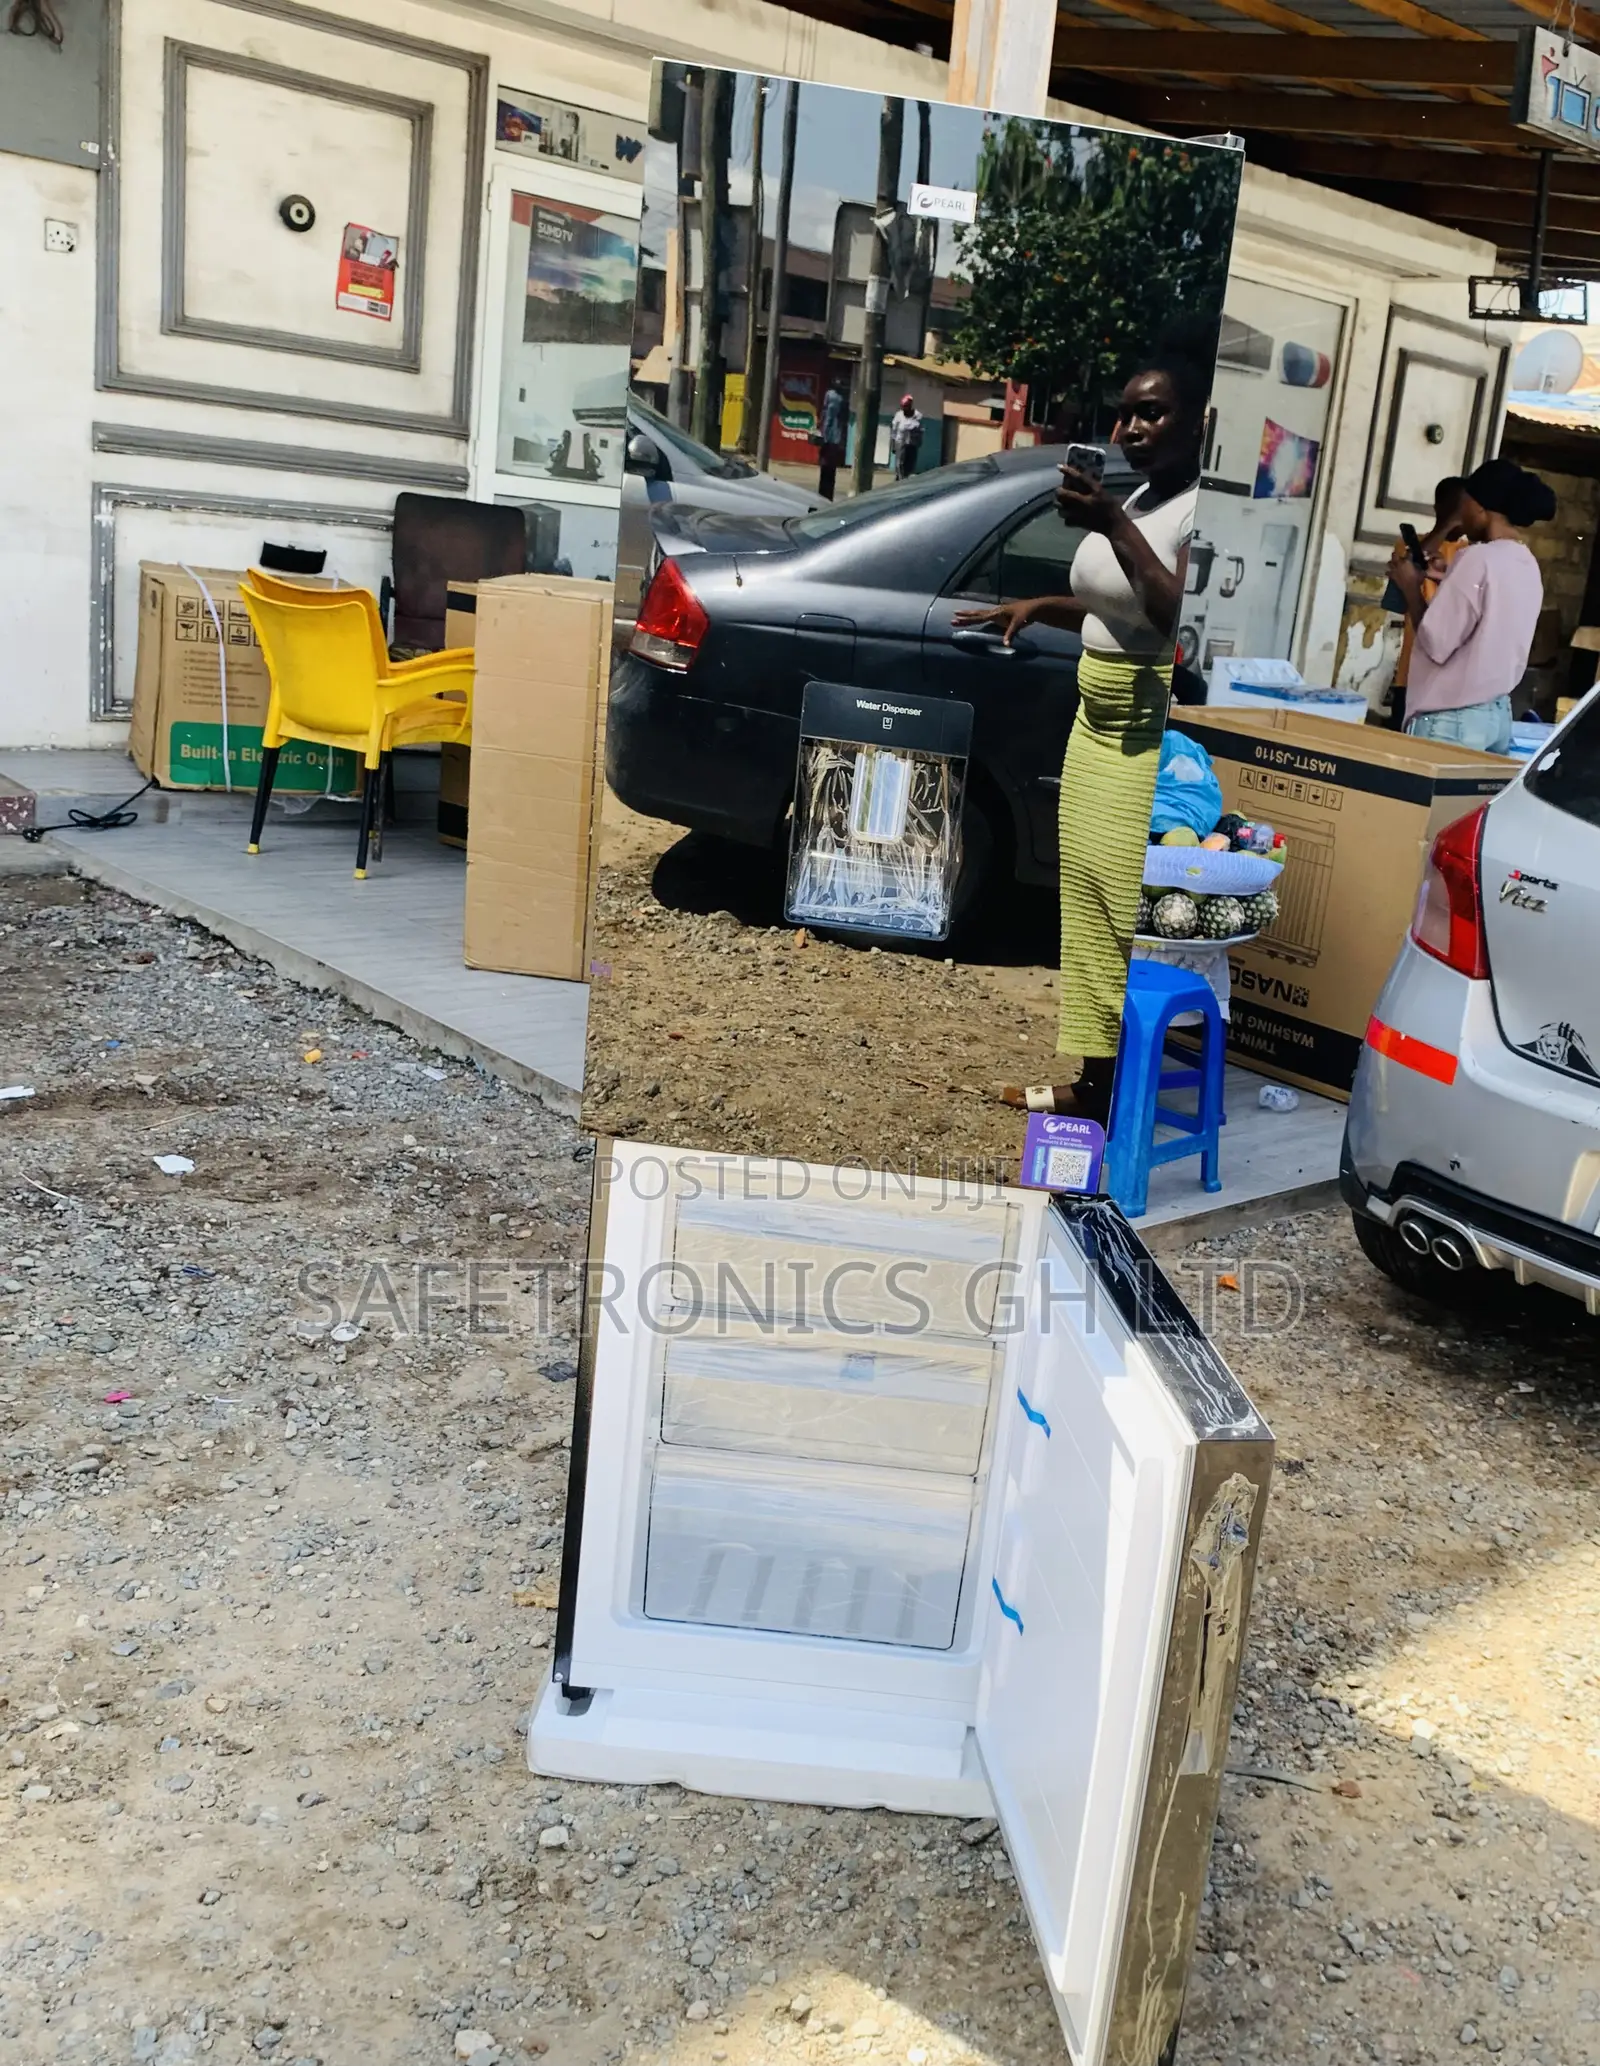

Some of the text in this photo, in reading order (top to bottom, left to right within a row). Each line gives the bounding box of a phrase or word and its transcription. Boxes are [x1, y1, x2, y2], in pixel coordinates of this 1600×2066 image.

[934, 197, 968, 211] PEARL
[856, 699, 922, 716] Water Dispenser
[181, 744, 236, 760] Built-n
[241, 747, 302, 764] Eleric
[1255, 746, 1337, 776] NASTT-JS110
[1499, 880, 1549, 913] Vitz
[1229, 964, 1293, 1003] NASC
[1227, 1028, 1276, 1055] TWIN-T
[1247, 1015, 1315, 1048] WASHING
[1060, 1122, 1091, 1134] PEARL
